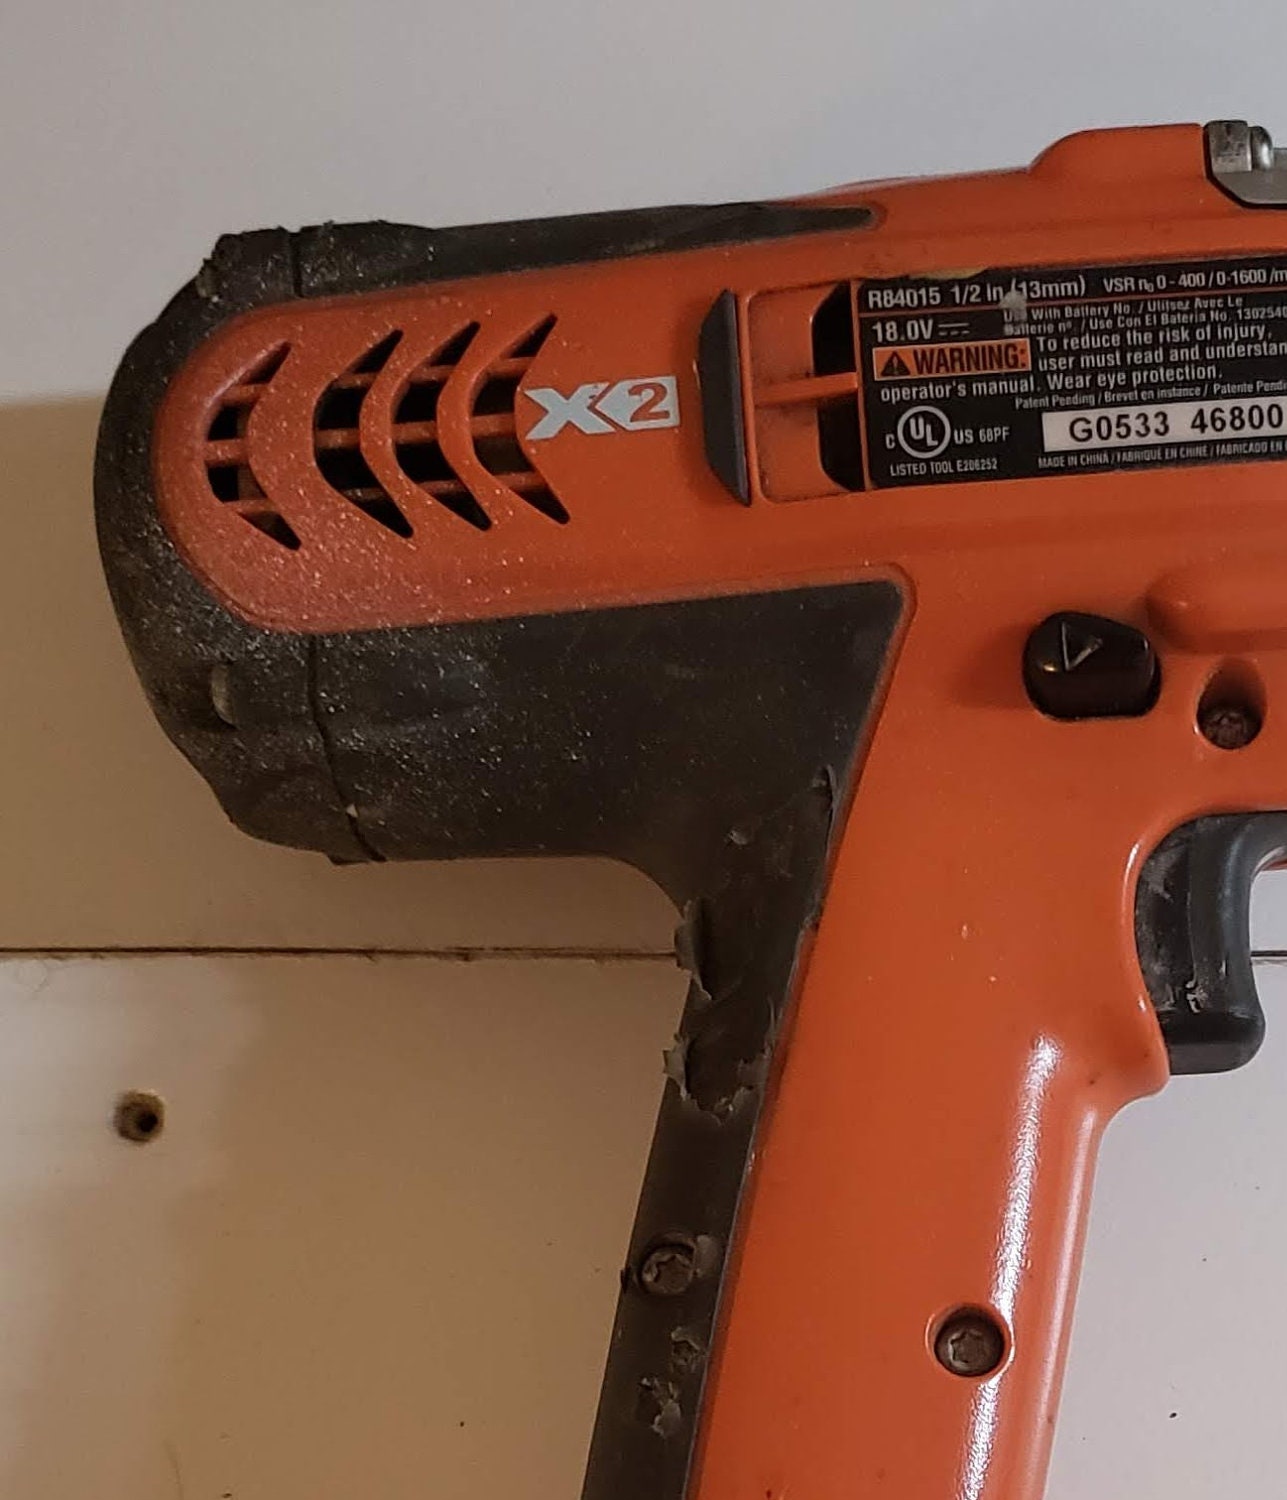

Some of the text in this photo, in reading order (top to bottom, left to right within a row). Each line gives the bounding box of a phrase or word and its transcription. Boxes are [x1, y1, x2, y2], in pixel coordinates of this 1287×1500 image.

[1102, 276, 1135, 293] VSR
[1178, 271, 1206, 288] 400
[867, 286, 941, 309] R84015
[950, 284, 981, 305] 1/2
[1031, 307, 1061, 321] With
[1064, 302, 1109, 319] Battery
[1090, 317, 1113, 331] Use
[1120, 314, 1141, 328] Con
[872, 318, 934, 343] 18.0V
[1036, 322, 1272, 352] To reduce the risk of injury,
[912, 342, 1028, 375] WARNING:
[1038, 355, 1075, 372] user
[1079, 350, 1121, 369] must
[1126, 346, 1164, 366] read
[1169, 344, 1200, 362] and
[880, 362, 1223, 405] operator's manual. Wear eye protection.
[1015, 395, 1050, 410] Patent
[1052, 392, 1096, 408] Pending
[1069, 403, 1284, 443] G0533 46800
[953, 428, 974, 445] US
[889, 461, 927, 477] LISTED
[930, 460, 955, 475] TOOL
[1038, 455, 1065, 469] MADE
[1067, 454, 1078, 467] IN
[1080, 452, 1109, 466] CHINA
